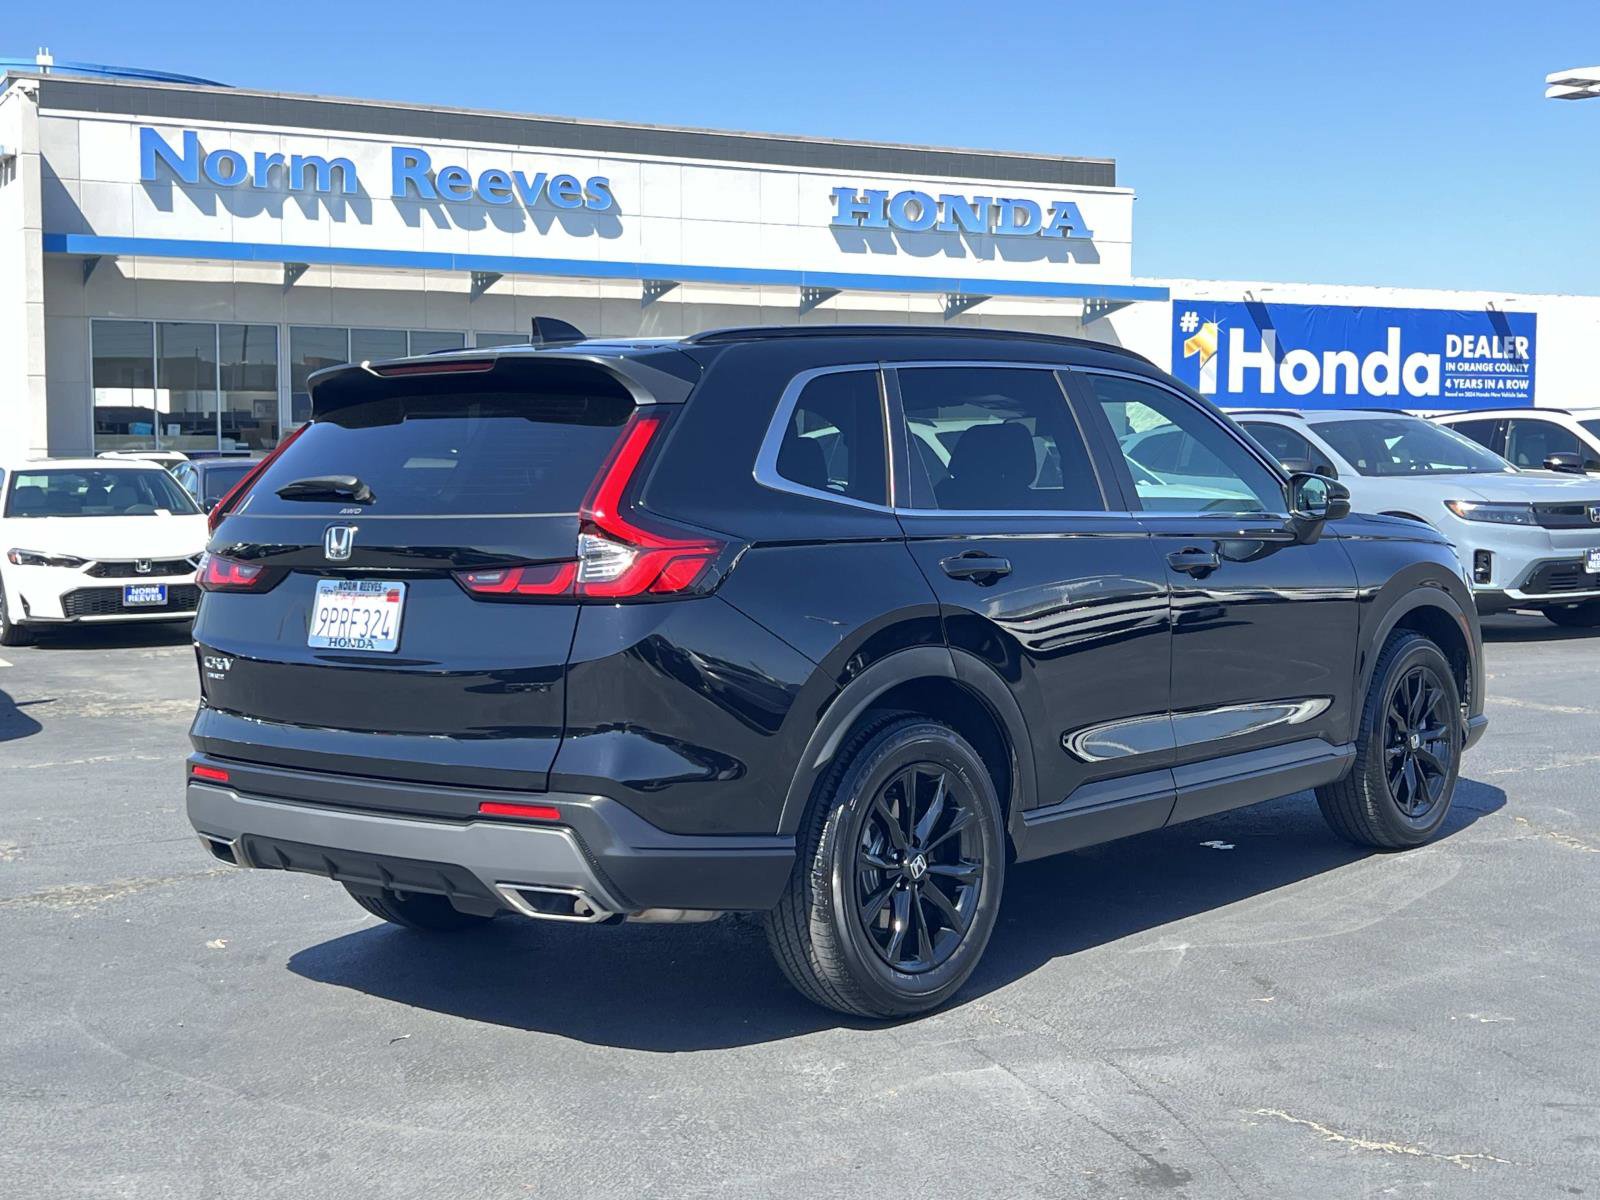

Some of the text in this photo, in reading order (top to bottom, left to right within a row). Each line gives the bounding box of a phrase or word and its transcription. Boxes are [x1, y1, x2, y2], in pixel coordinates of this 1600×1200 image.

[140, 126, 612, 212] Norm Reeves
[829, 186, 1094, 239] HONDA
[1445, 334, 1530, 360] DEALER
[1228, 327, 1441, 396] Honda
[1445, 362, 1530, 373] IN ORANGE COUNTY
[1444, 378, 1530, 390] 4 YEARS IN A ROW
[131, 587, 159, 595] NORM
[339, 581, 357, 591] NORM
[127, 594, 163, 602] REEVES
[328, 637, 375, 649] HONDA
